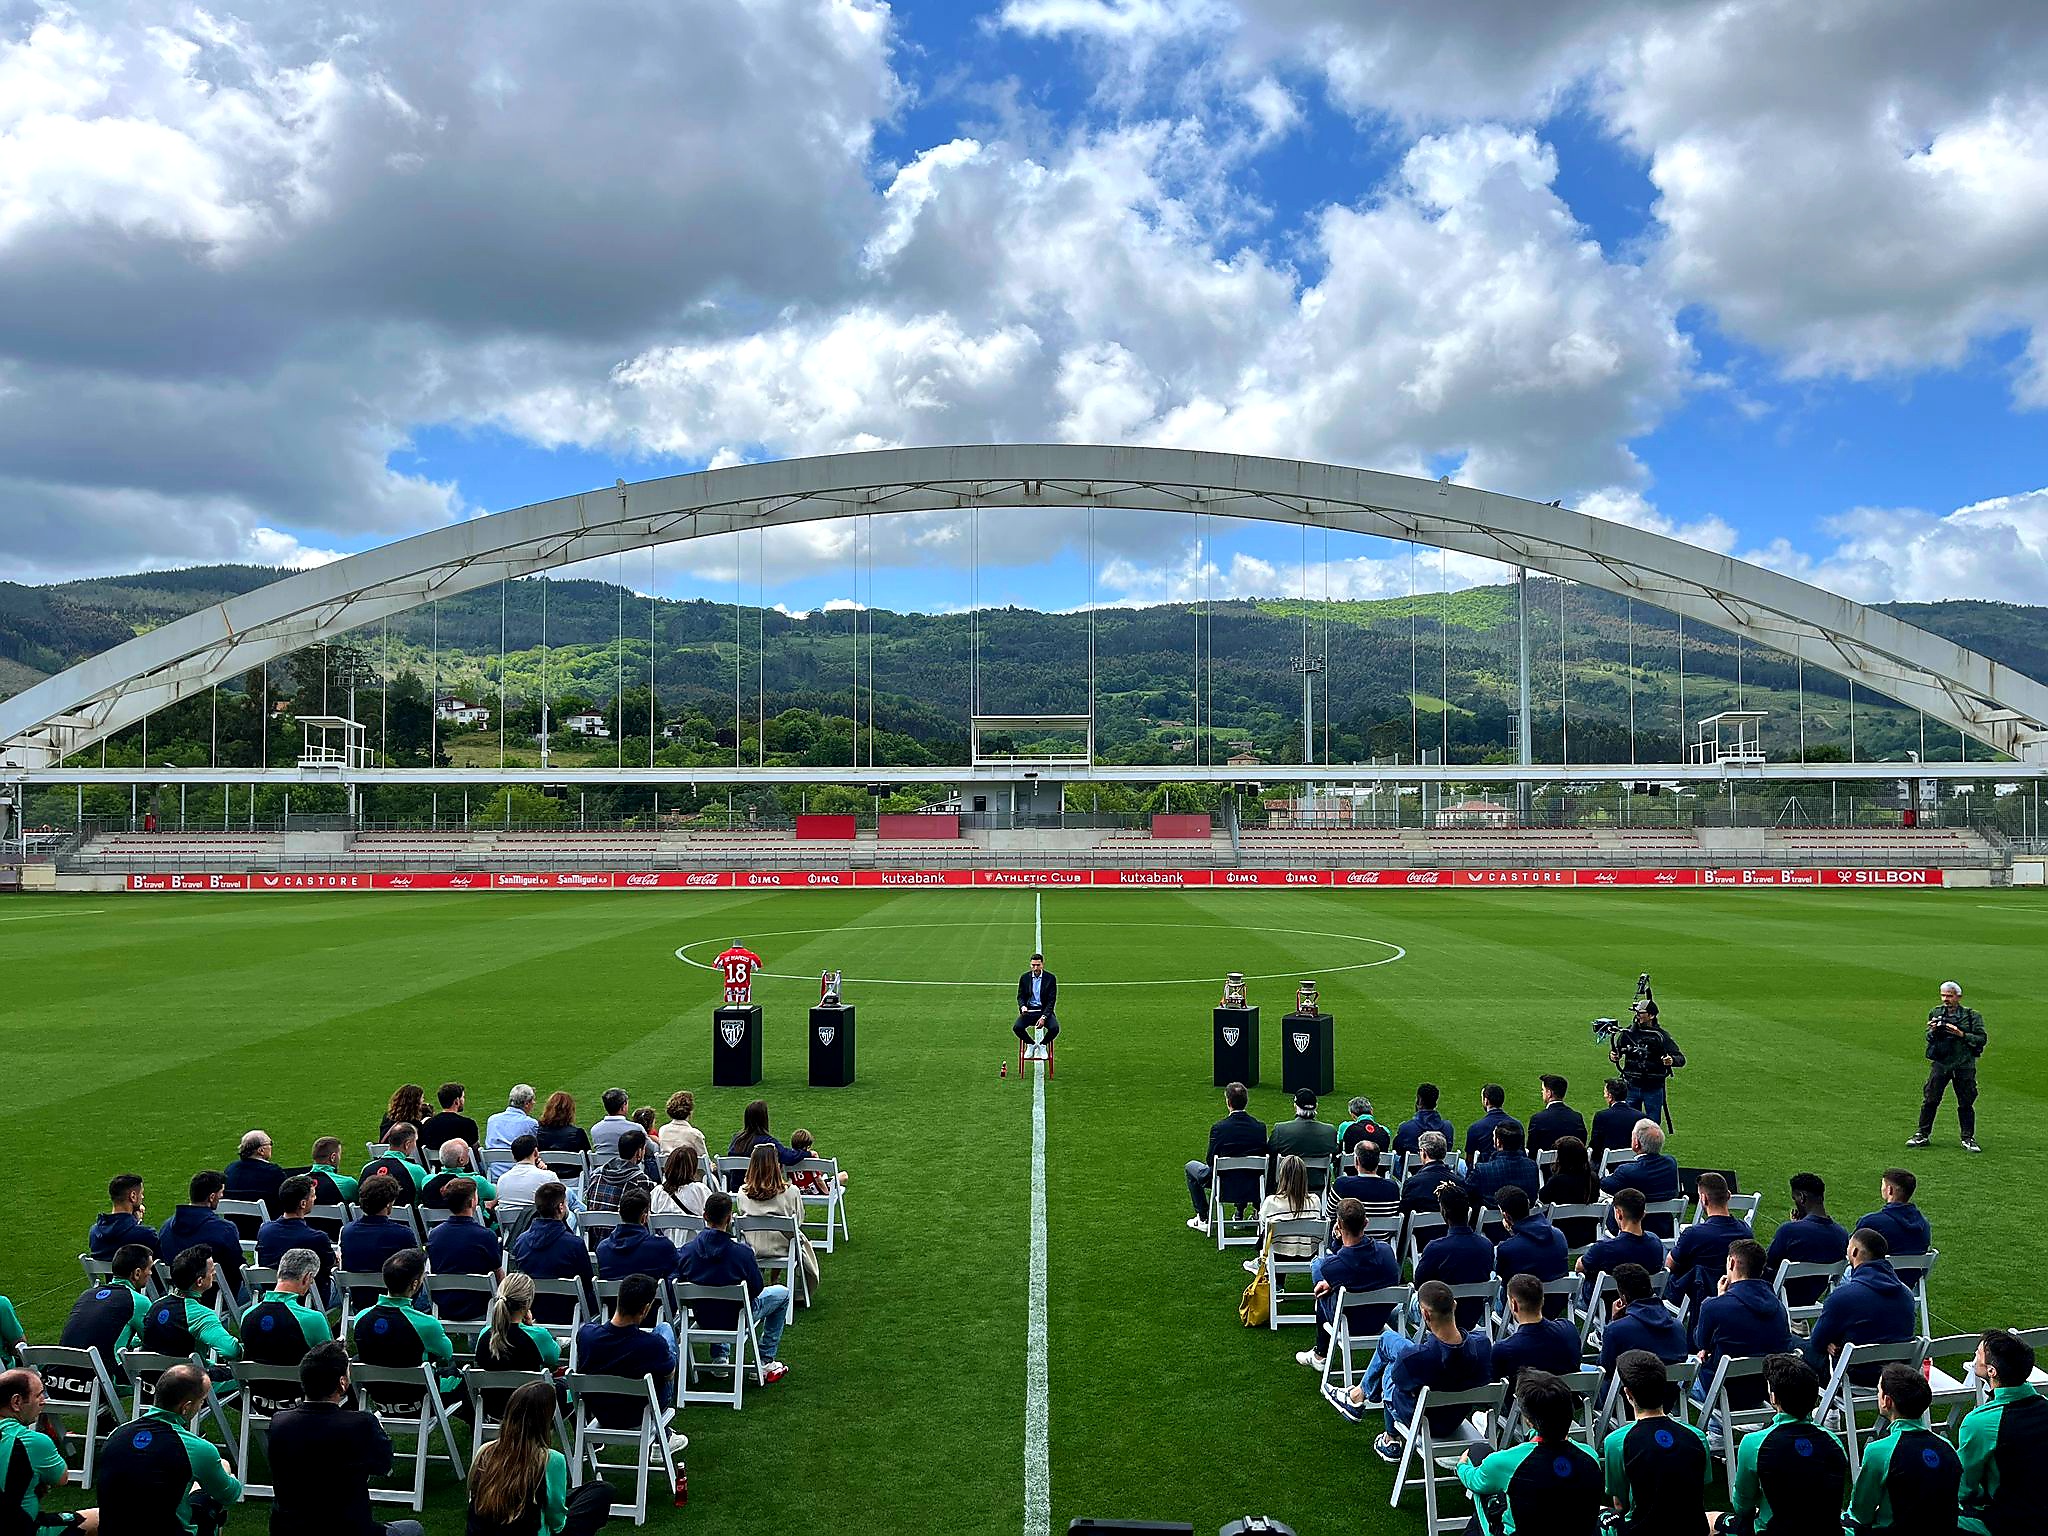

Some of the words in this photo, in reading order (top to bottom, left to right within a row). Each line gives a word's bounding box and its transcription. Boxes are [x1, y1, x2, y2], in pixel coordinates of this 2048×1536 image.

[284, 876, 358, 886] CASTORE
[757, 875, 781, 885] IMQ
[816, 875, 840, 885] IMQ
[881, 872, 945, 884] kutxabank
[994, 872, 1048, 882] ATHLETIC
[1051, 872, 1081, 882] CLUB
[1120, 871, 1184, 883] kutxabank
[1235, 874, 1258, 883] IMQ
[1294, 874, 1318, 883] IMQ
[1488, 872, 1561, 881] CASTORE
[1855, 871, 1926, 883] SILBON
[726, 963, 747, 983] 18
